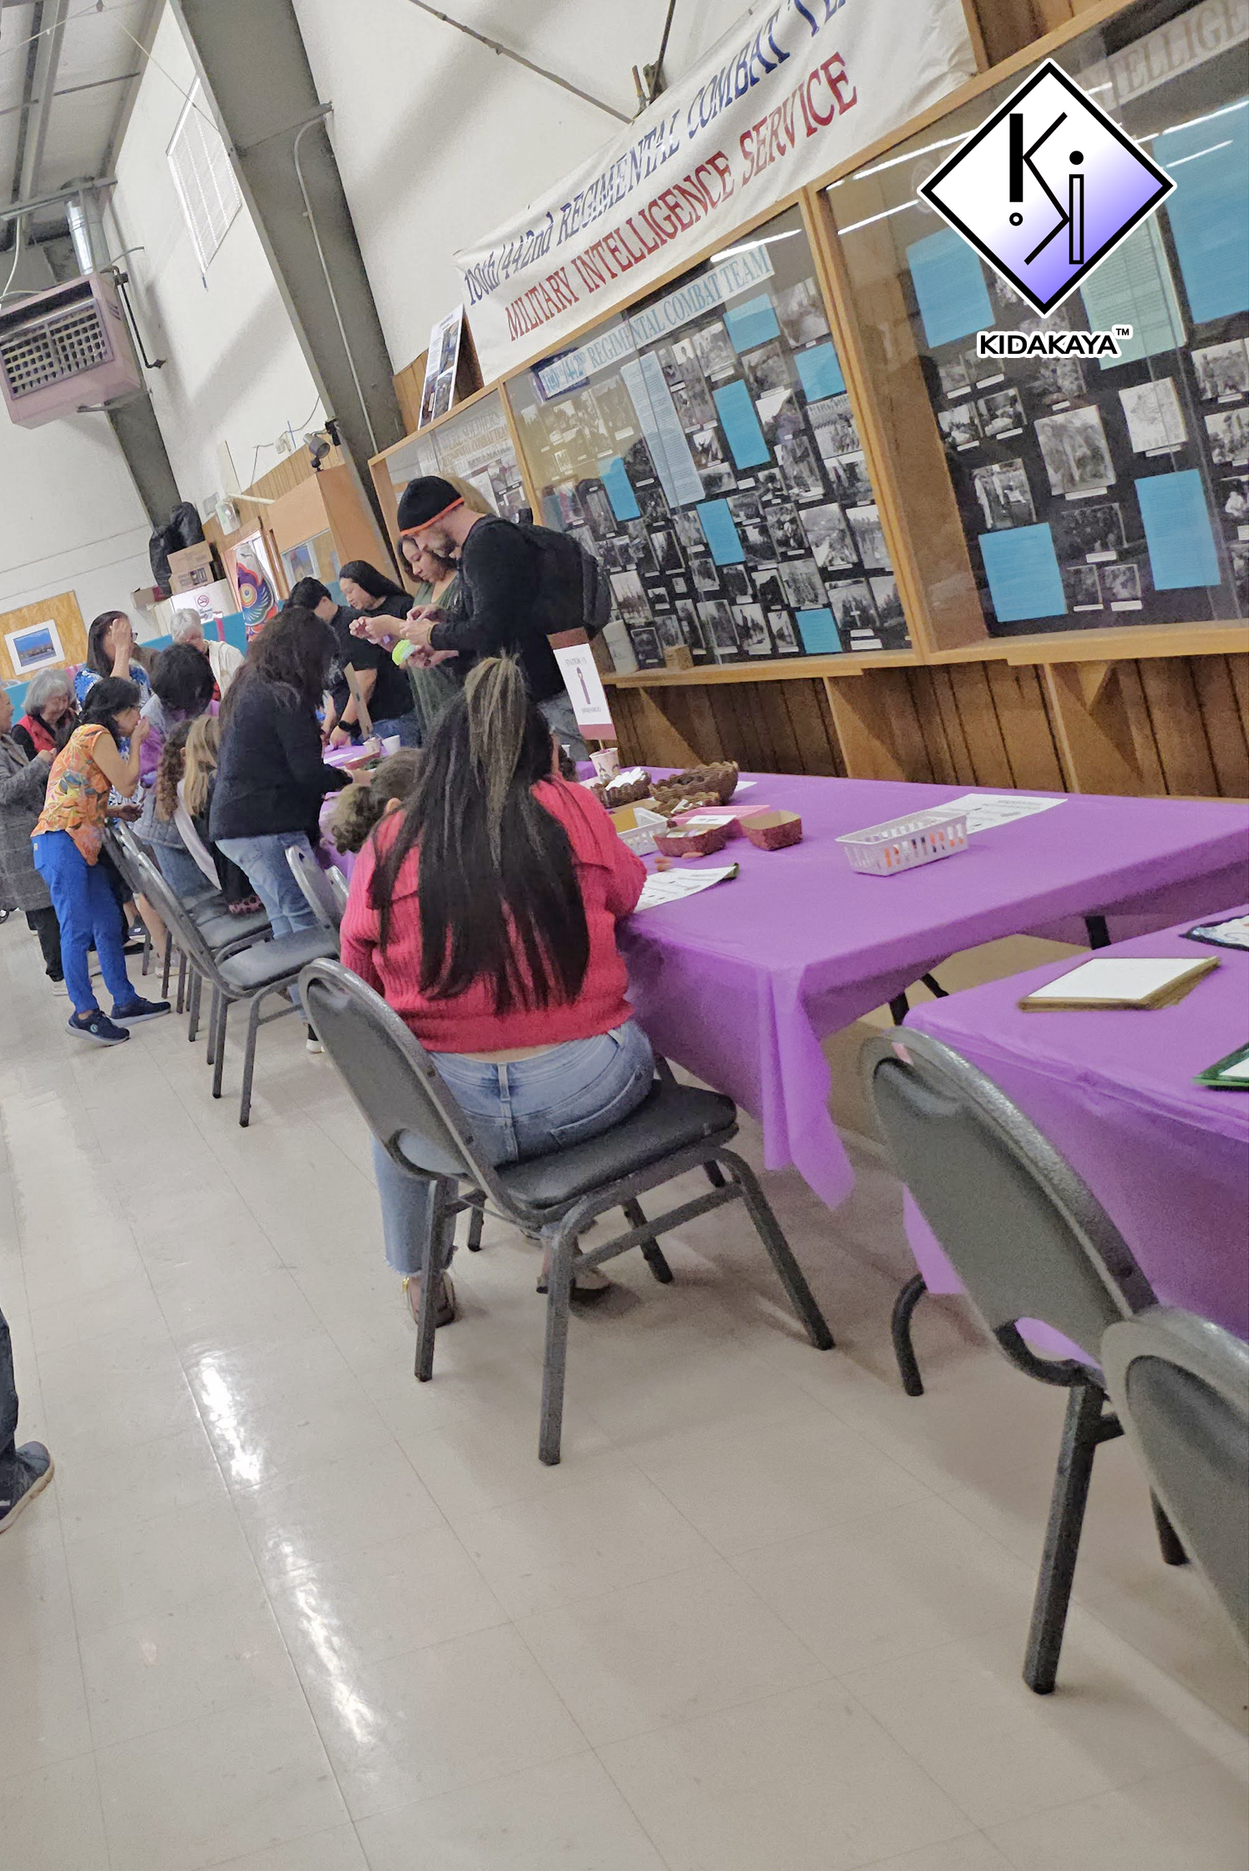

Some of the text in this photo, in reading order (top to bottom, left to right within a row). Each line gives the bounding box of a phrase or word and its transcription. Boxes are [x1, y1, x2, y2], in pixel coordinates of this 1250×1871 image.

[505, 51, 858, 342] MILITARY INTELLIGENCE SERVICE
[557, 110, 681, 245] REGIMENTAL
[687, 5, 790, 139] COMBAT
[588, 316, 663, 366] REGIMENTAL
[664, 281, 724, 329] COMBAT
[721, 247, 771, 296] TEAM
